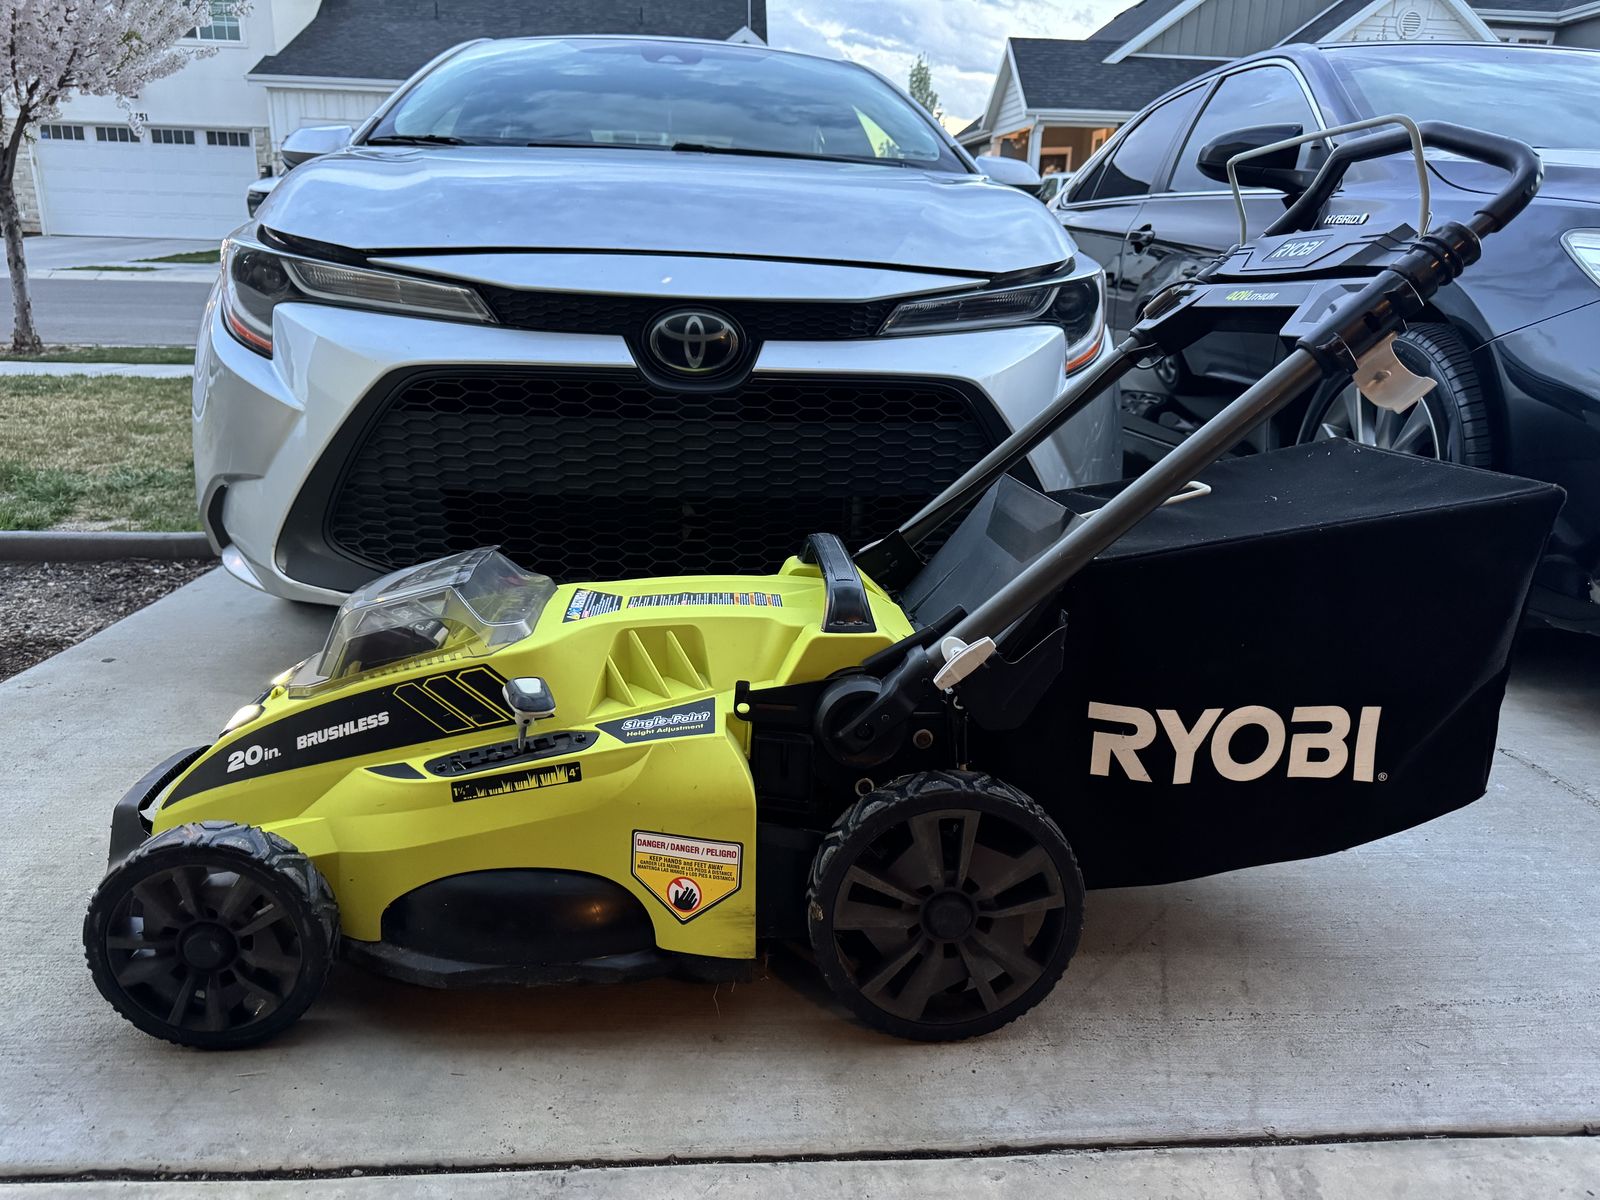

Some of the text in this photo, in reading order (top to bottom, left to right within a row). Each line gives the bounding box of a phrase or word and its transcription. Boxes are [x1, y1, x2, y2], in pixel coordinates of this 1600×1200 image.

[1271, 240, 1325, 258] RYOBI
[622, 711, 711, 731] Single-Point
[626, 723, 704, 737] Height Adjustment
[297, 711, 389, 750] BRUSHLESS
[637, 838, 666, 850] DANGER
[670, 843, 700, 855] DANGER
[706, 848, 737, 859] PELIGRO
[637, 864, 660, 872] MANTENGA
[713, 874, 735, 882] DISTANCIA
[663, 857, 682, 865] HANDS
[694, 861, 707, 869] FEET
[707, 863, 724, 871] AWAY
[712, 869, 733, 877] DISTANCE
